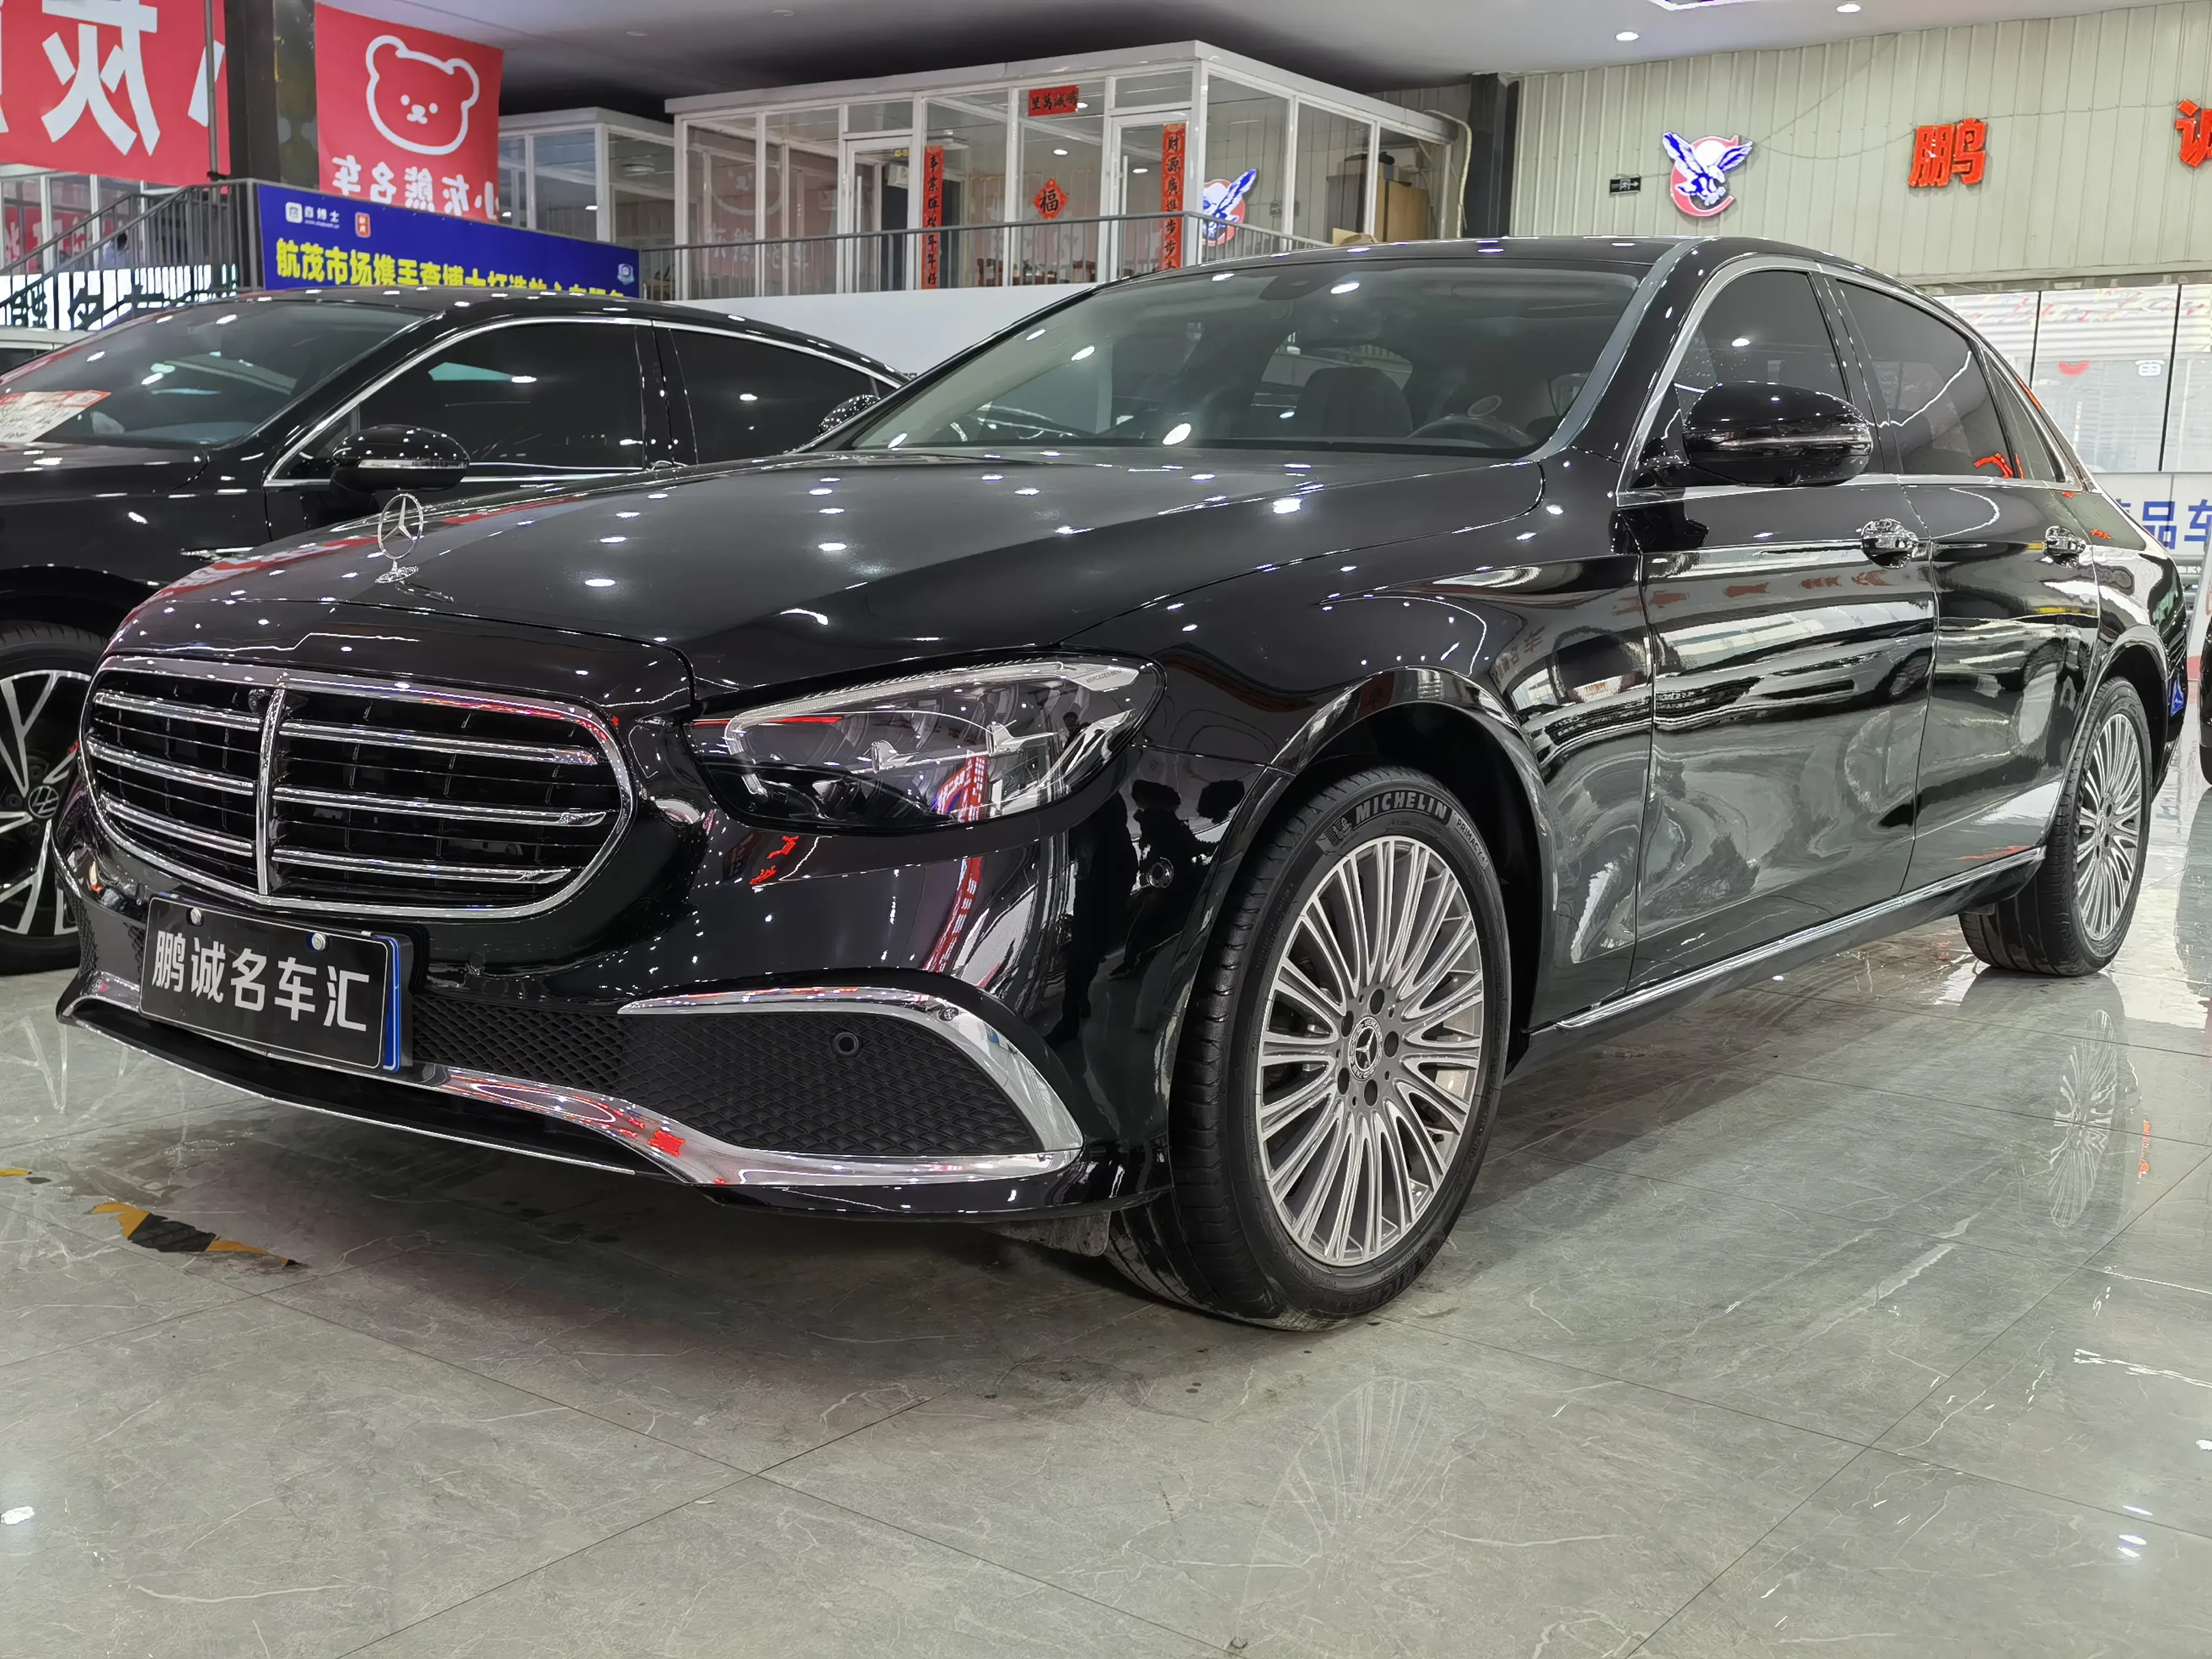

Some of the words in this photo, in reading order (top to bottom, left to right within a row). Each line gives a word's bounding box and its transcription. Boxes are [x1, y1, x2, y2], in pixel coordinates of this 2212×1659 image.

[1038, 188, 1059, 213] 福
[1355, 792, 1447, 825] MICHELIN
[1456, 819, 1482, 857] PRIMACY
[152, 930, 370, 1032] 鹏诚名车汇
